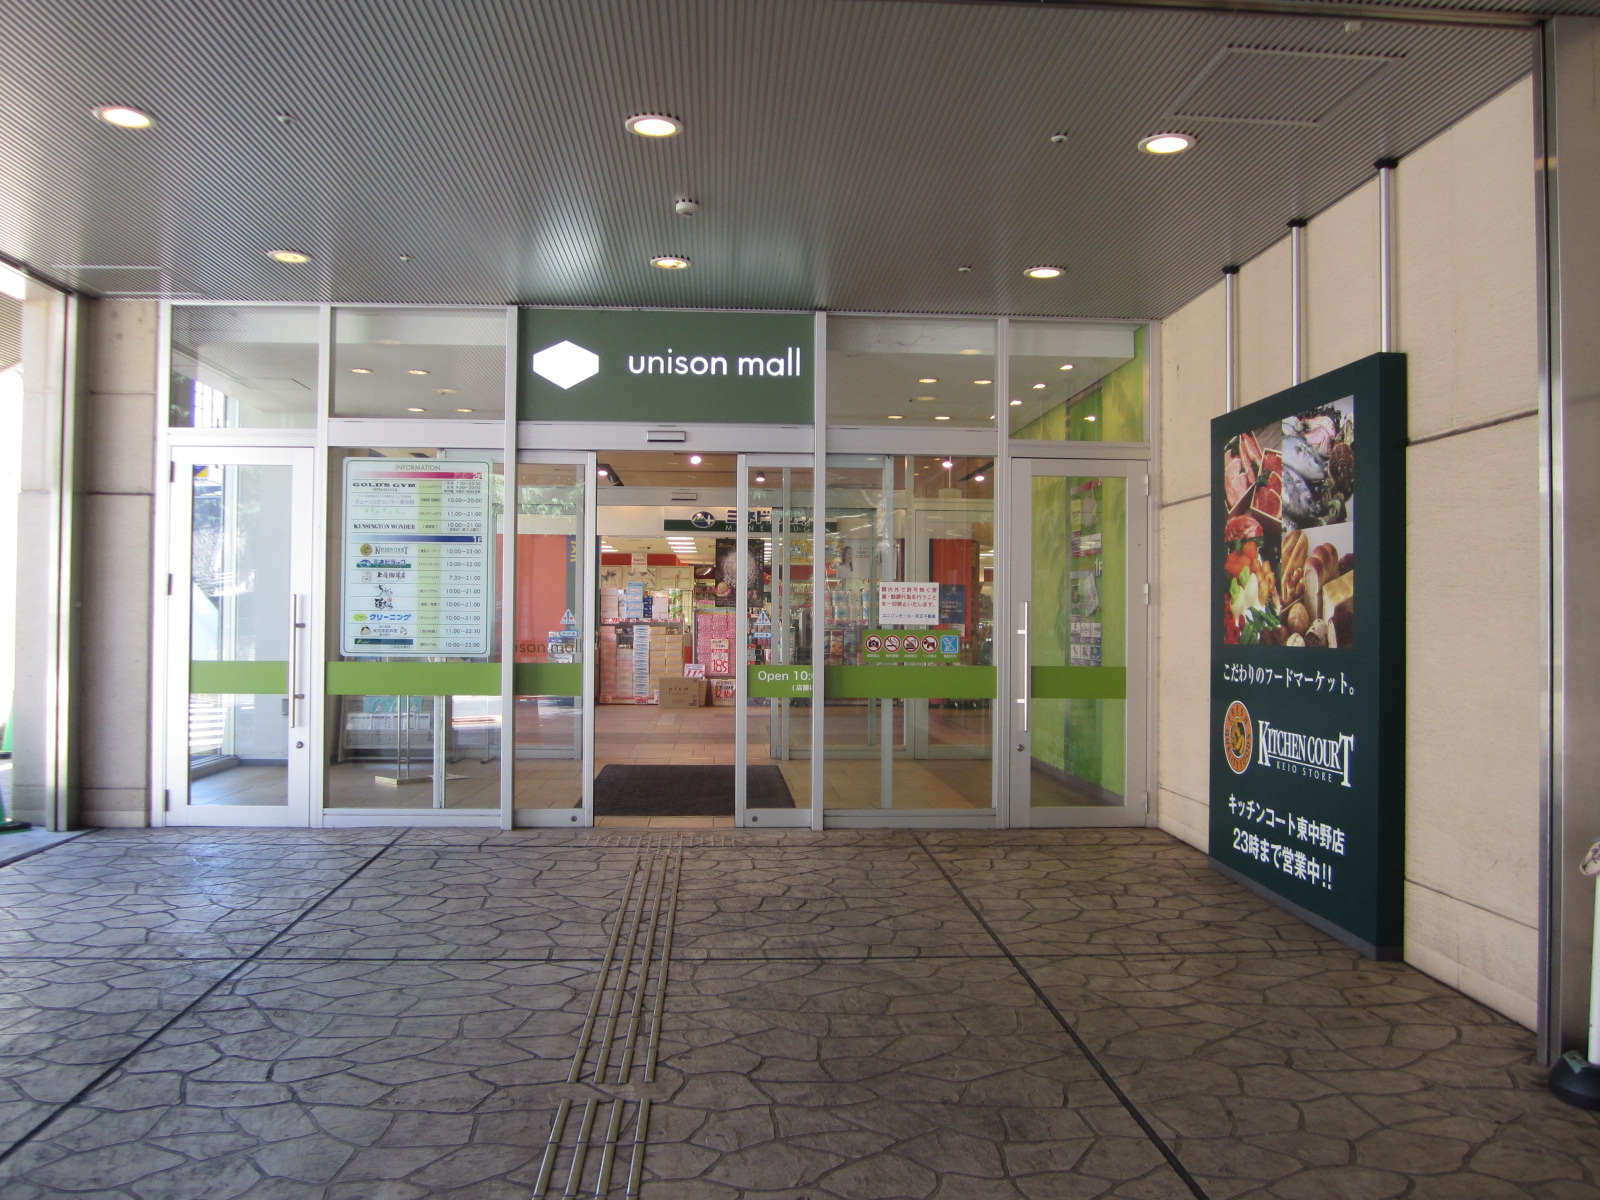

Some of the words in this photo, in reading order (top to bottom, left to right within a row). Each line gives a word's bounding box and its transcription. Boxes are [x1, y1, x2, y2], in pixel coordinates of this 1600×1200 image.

[628, 348, 728, 375] unison
[738, 347, 800, 376] mall
[472, 472, 483, 480] 2F
[369, 613, 412, 621] クリーニング
[551, 636, 582, 654] mall
[757, 670, 789, 683] Open
[793, 670, 813, 681] 10:
[1223, 663, 1354, 695] こだわりのフードマーケット。
[1257, 720, 1306, 768] KITCHEN
[1307, 731, 1354, 788] COURT
[1276, 761, 1298, 774] KEIO
[1302, 767, 1332, 783] STORE
[1228, 793, 1345, 856] キッチンコート東中野店
[1233, 827, 1333, 890] 23時まで営業中!!
